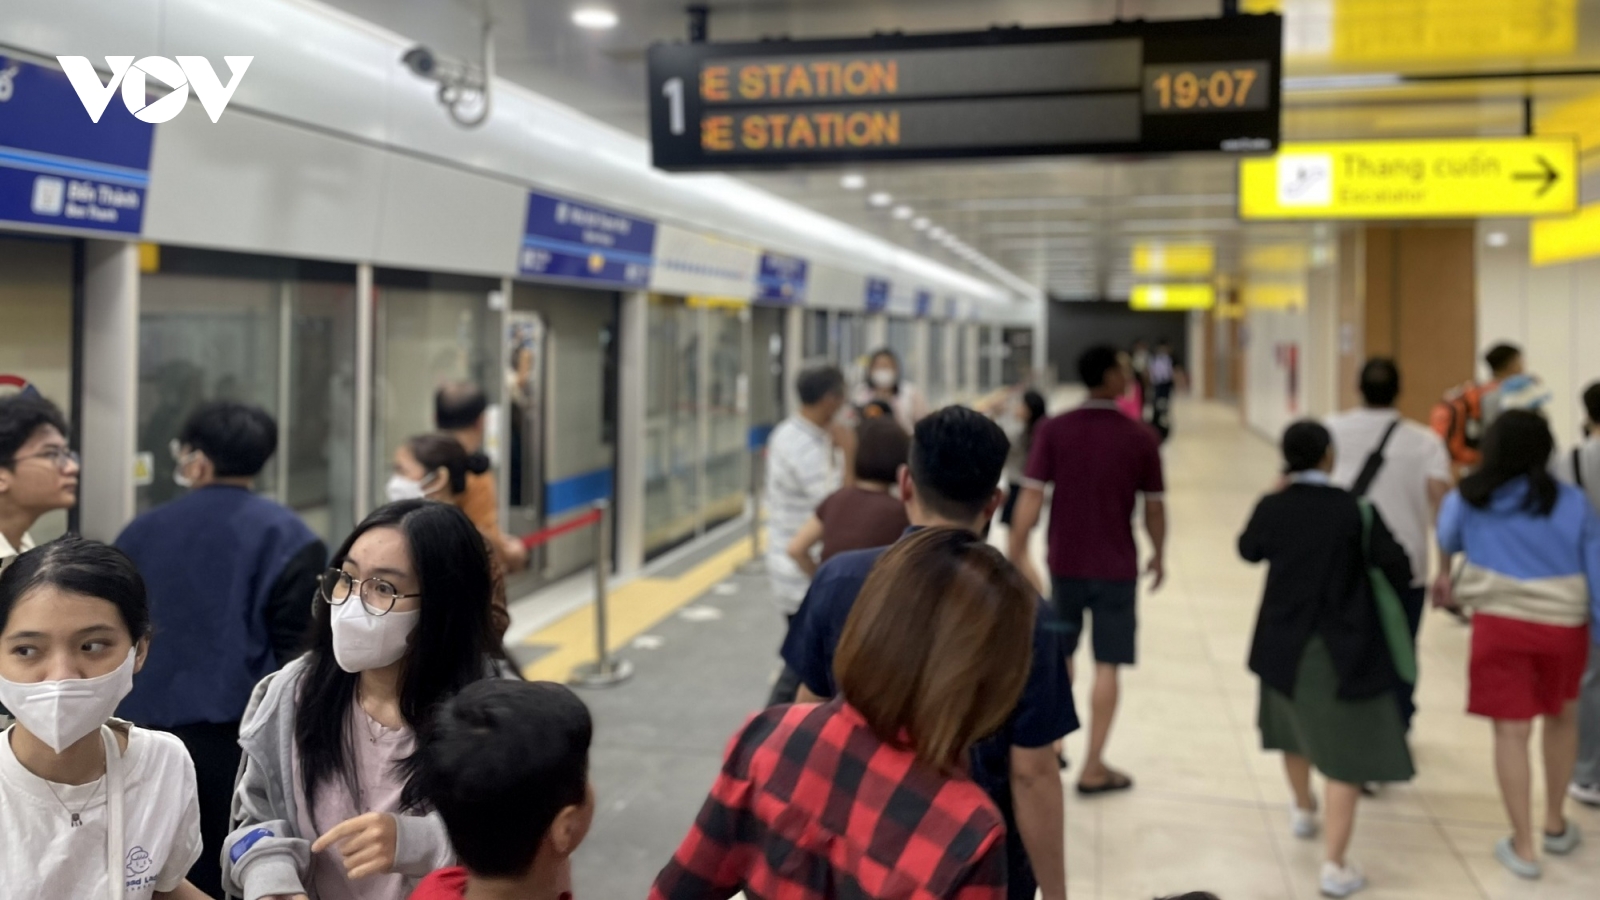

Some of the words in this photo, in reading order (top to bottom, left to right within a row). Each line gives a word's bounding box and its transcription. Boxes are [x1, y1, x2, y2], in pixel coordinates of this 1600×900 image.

[738, 59, 898, 99] STATION
[1153, 69, 1257, 108] 19:07
[662, 77, 685, 135] 1
[742, 110, 899, 149] STATION
[1342, 153, 1425, 184] Thang
